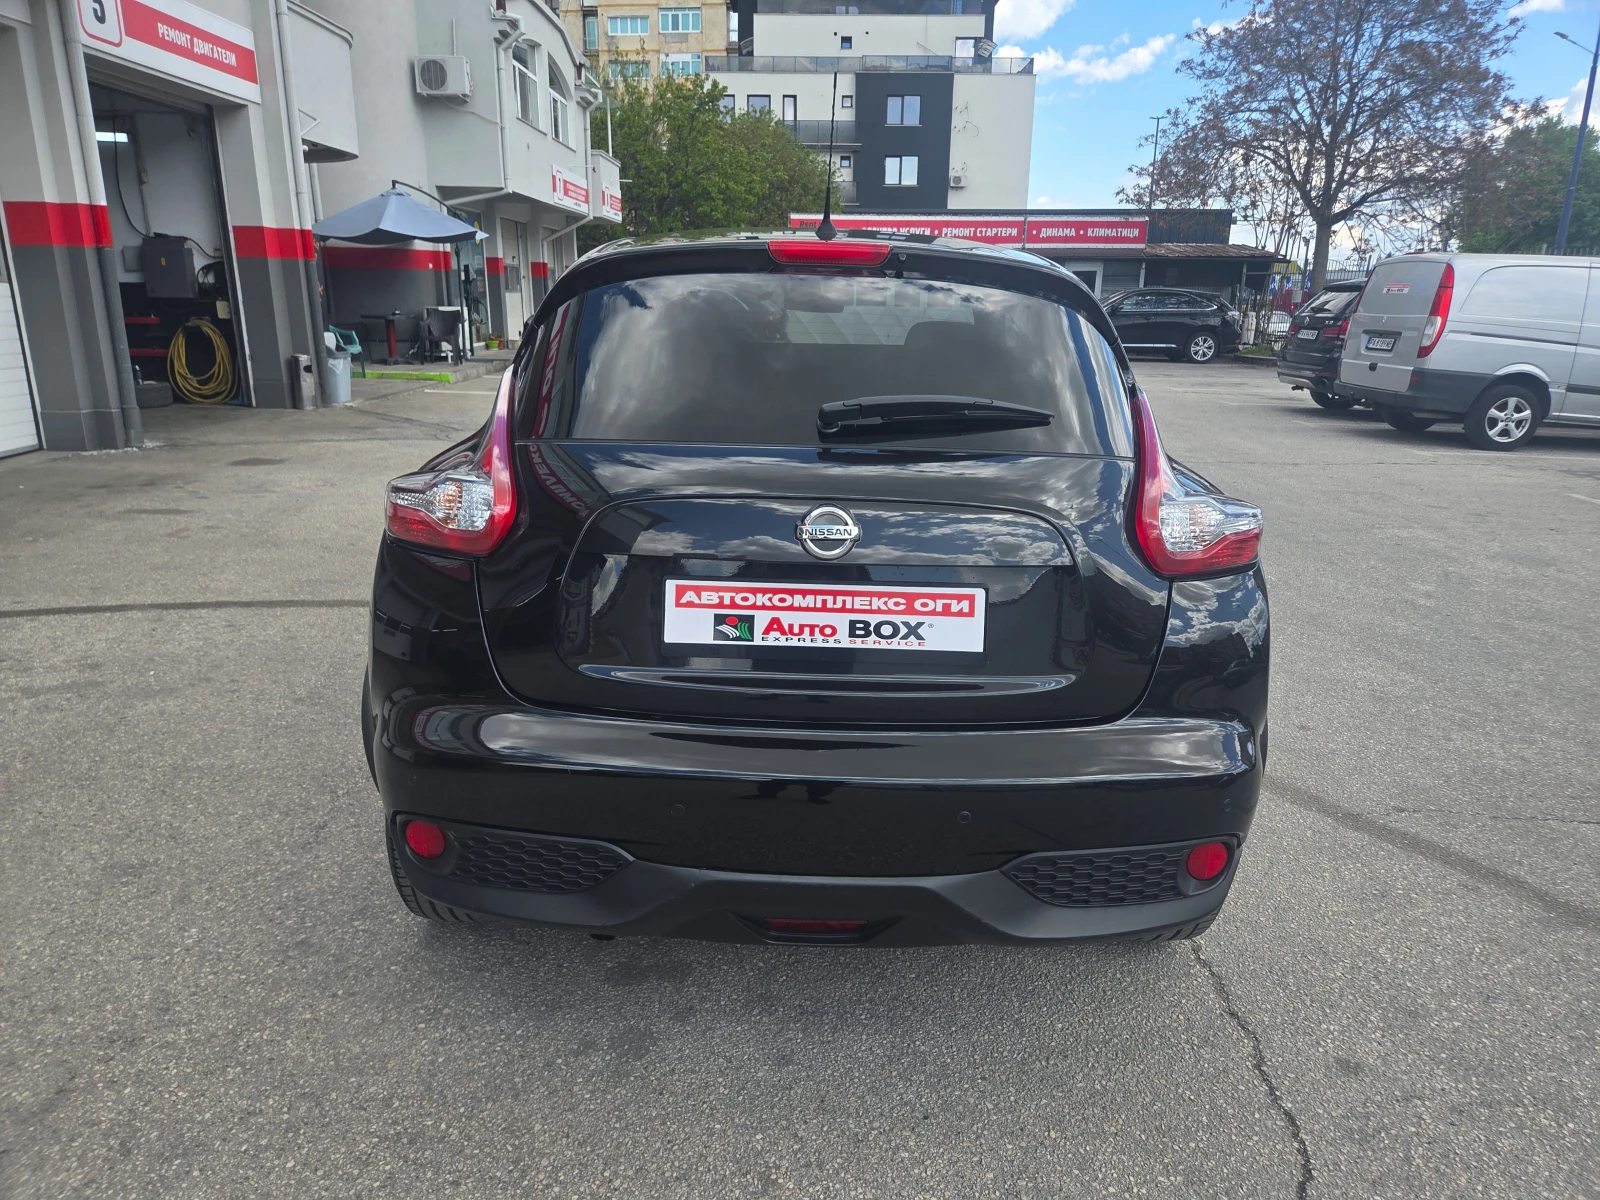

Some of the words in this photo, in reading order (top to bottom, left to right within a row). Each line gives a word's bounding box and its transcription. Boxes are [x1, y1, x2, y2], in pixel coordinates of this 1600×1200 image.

[157, 22, 191, 49] РЕМОНТ
[193, 37, 237, 67] ДВИГАТЕЛИ
[942, 227, 974, 237] РЕМОНТ
[977, 227, 1018, 237] СТАРТЕРИ
[1040, 227, 1076, 238] ДИНАМА
[1087, 227, 1139, 238] КЛИМАТИЦИ
[804, 527, 852, 537] NISSAN
[679, 590, 907, 610] АВТОКОМПЛЕКС
[913, 598, 969, 613] ОГИ
[848, 619, 927, 641] BOX
[761, 636, 842, 644] EXPRESS
[848, 639, 926, 647] SERVICE
